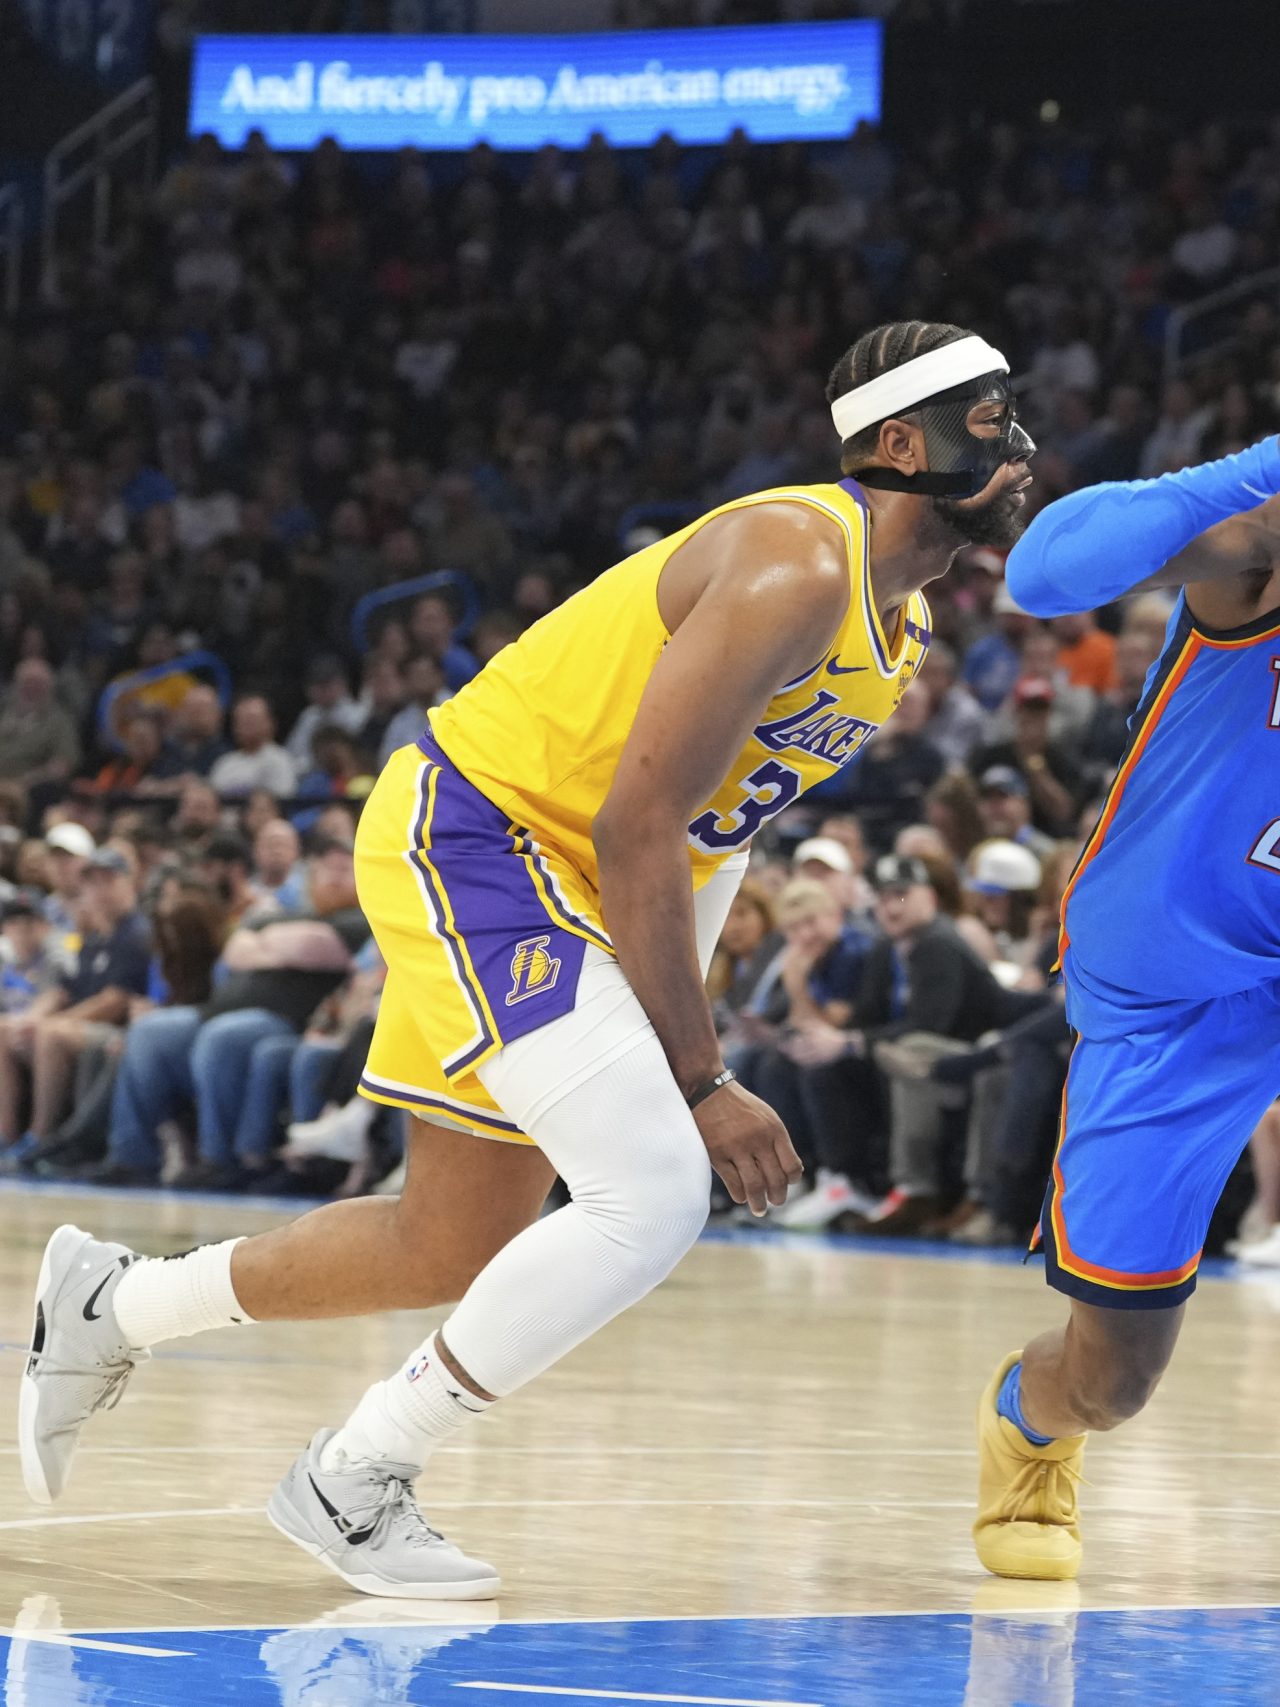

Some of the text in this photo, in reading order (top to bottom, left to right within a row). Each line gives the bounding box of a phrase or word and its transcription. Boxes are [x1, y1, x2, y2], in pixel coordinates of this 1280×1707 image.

[221, 62, 315, 113] And
[319, 61, 467, 127] fiercely
[468, 74, 546, 127] pro
[548, 60, 719, 112] American
